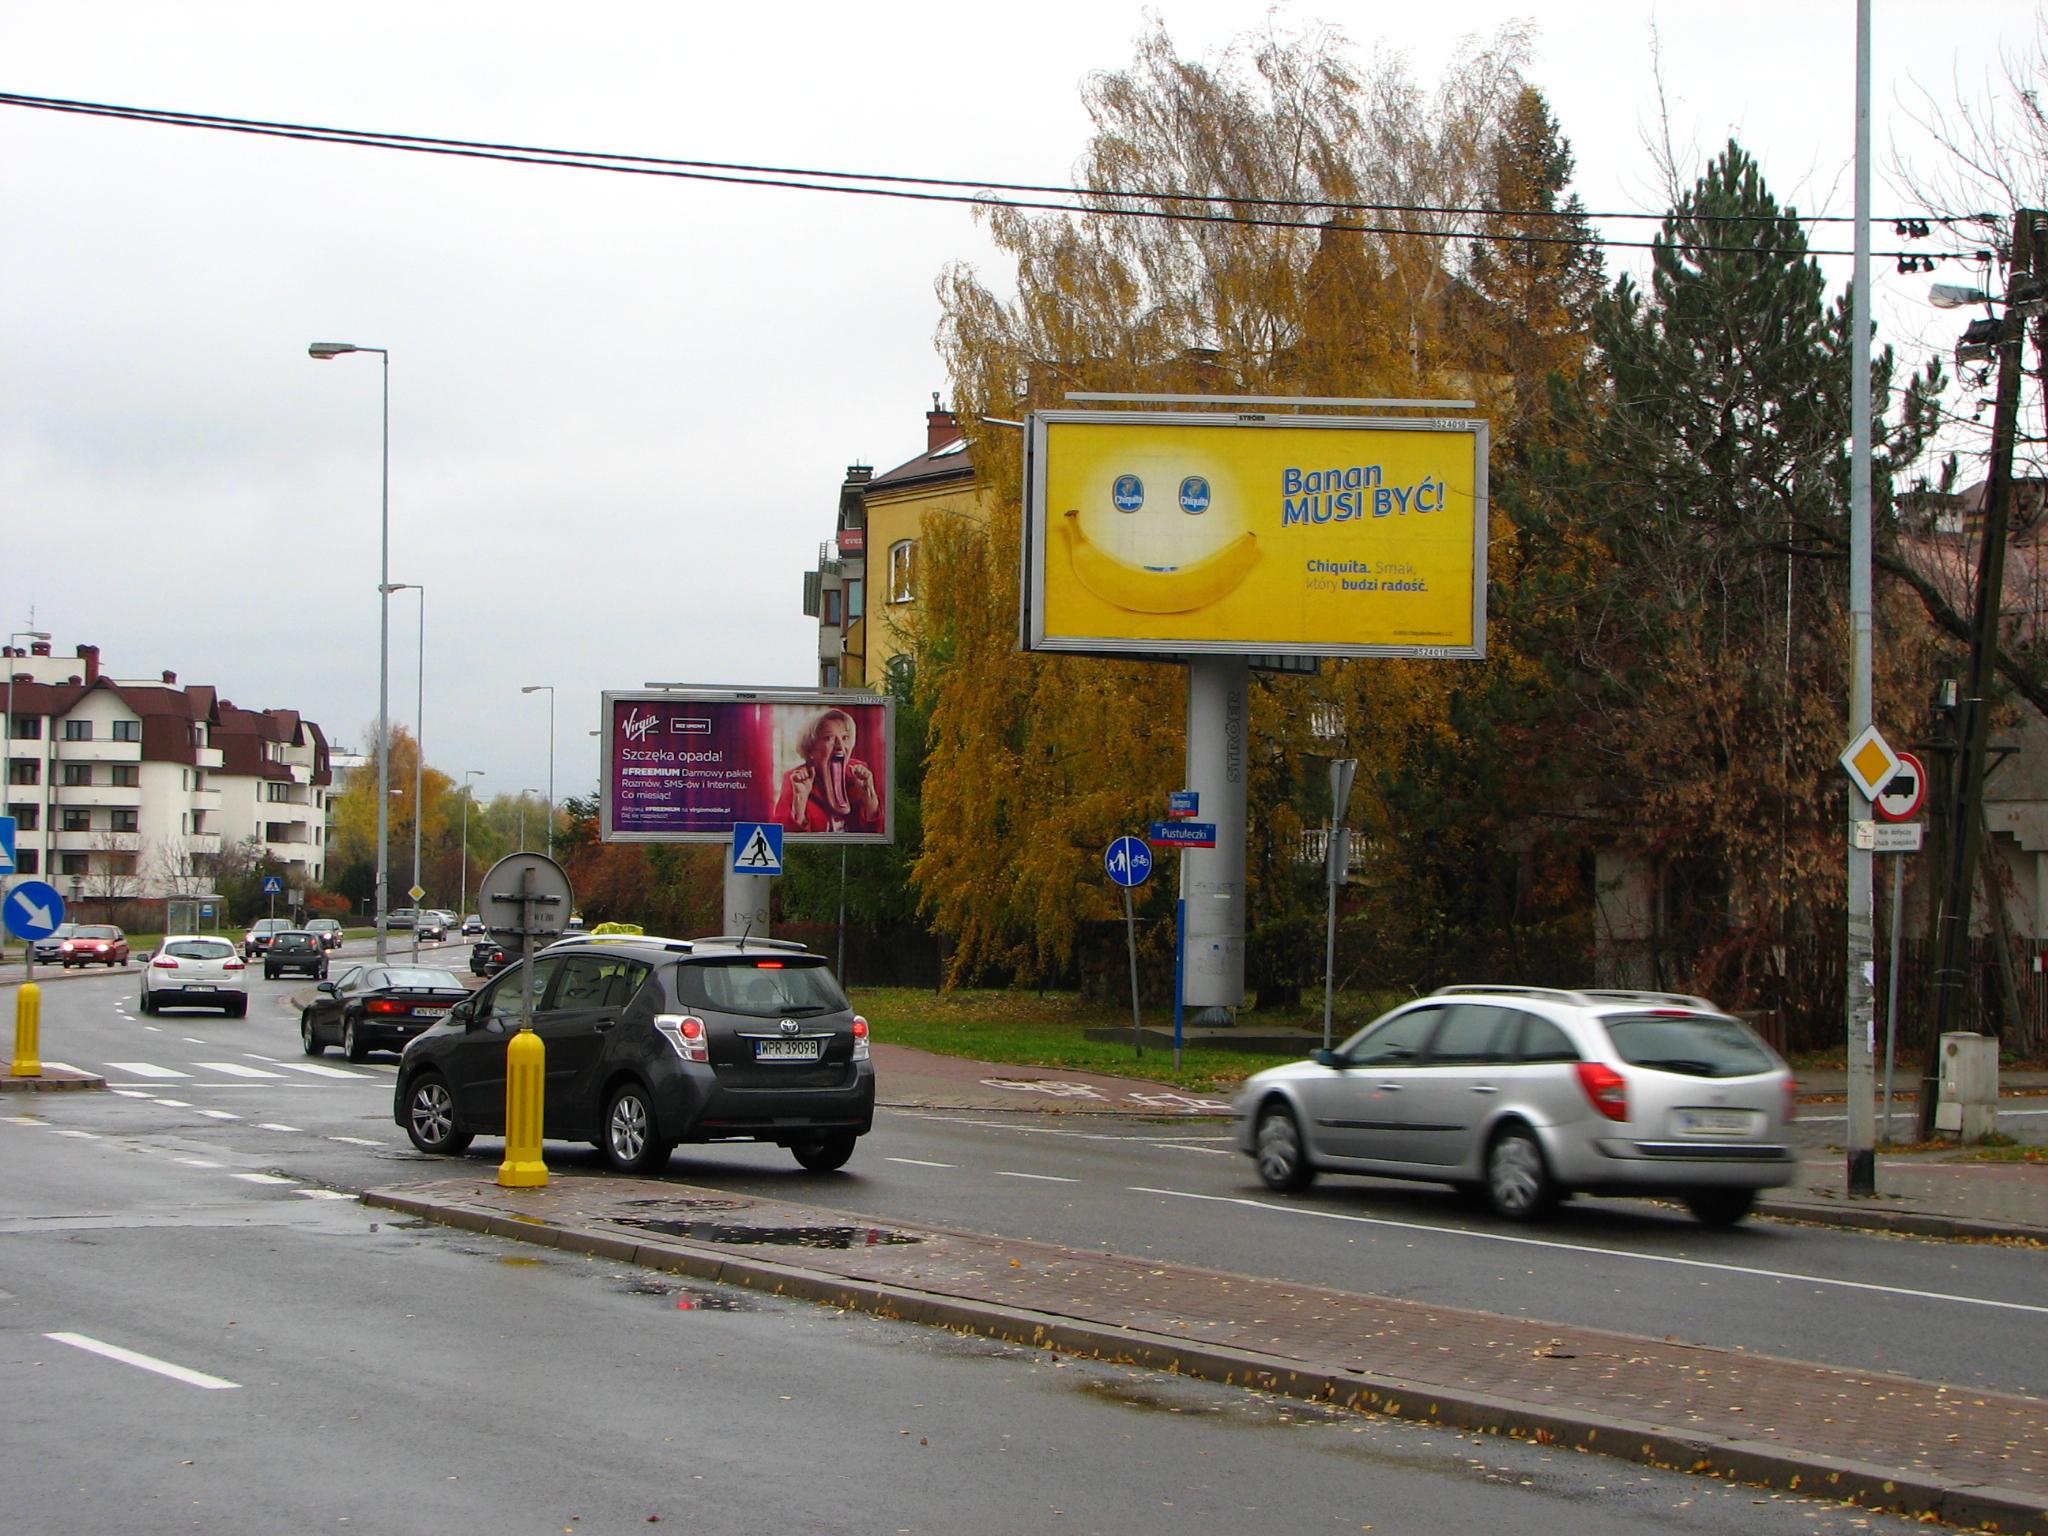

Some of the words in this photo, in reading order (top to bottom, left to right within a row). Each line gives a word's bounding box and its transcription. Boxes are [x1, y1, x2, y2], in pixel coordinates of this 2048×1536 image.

[1282, 463, 1384, 497] Banan
[1282, 490, 1363, 527] MUSI
[1372, 475, 1445, 517] BYĆ!
[1306, 559, 1371, 575] Chiquita.
[1375, 561, 1417, 576] Smak,
[1306, 577, 1338, 593] który
[1341, 578, 1378, 591] budzi
[1381, 577, 1428, 592] radość.
[622, 707, 660, 742] Virgin
[622, 748, 675, 763] Szczęka
[678, 749, 723, 763] opada!
[622, 767, 680, 777] #FREEMIUM
[681, 769, 724, 779] Darmowy
[726, 769, 753, 779] pakiet
[621, 779, 661, 789] Rozmów,
[664, 779, 700, 789] SMS-ów
[621, 790, 634, 799] Co
[637, 790, 672, 801] miesiąc!
[762, 1042, 782, 1055] WPR
[785, 1042, 816, 1054] 39098
